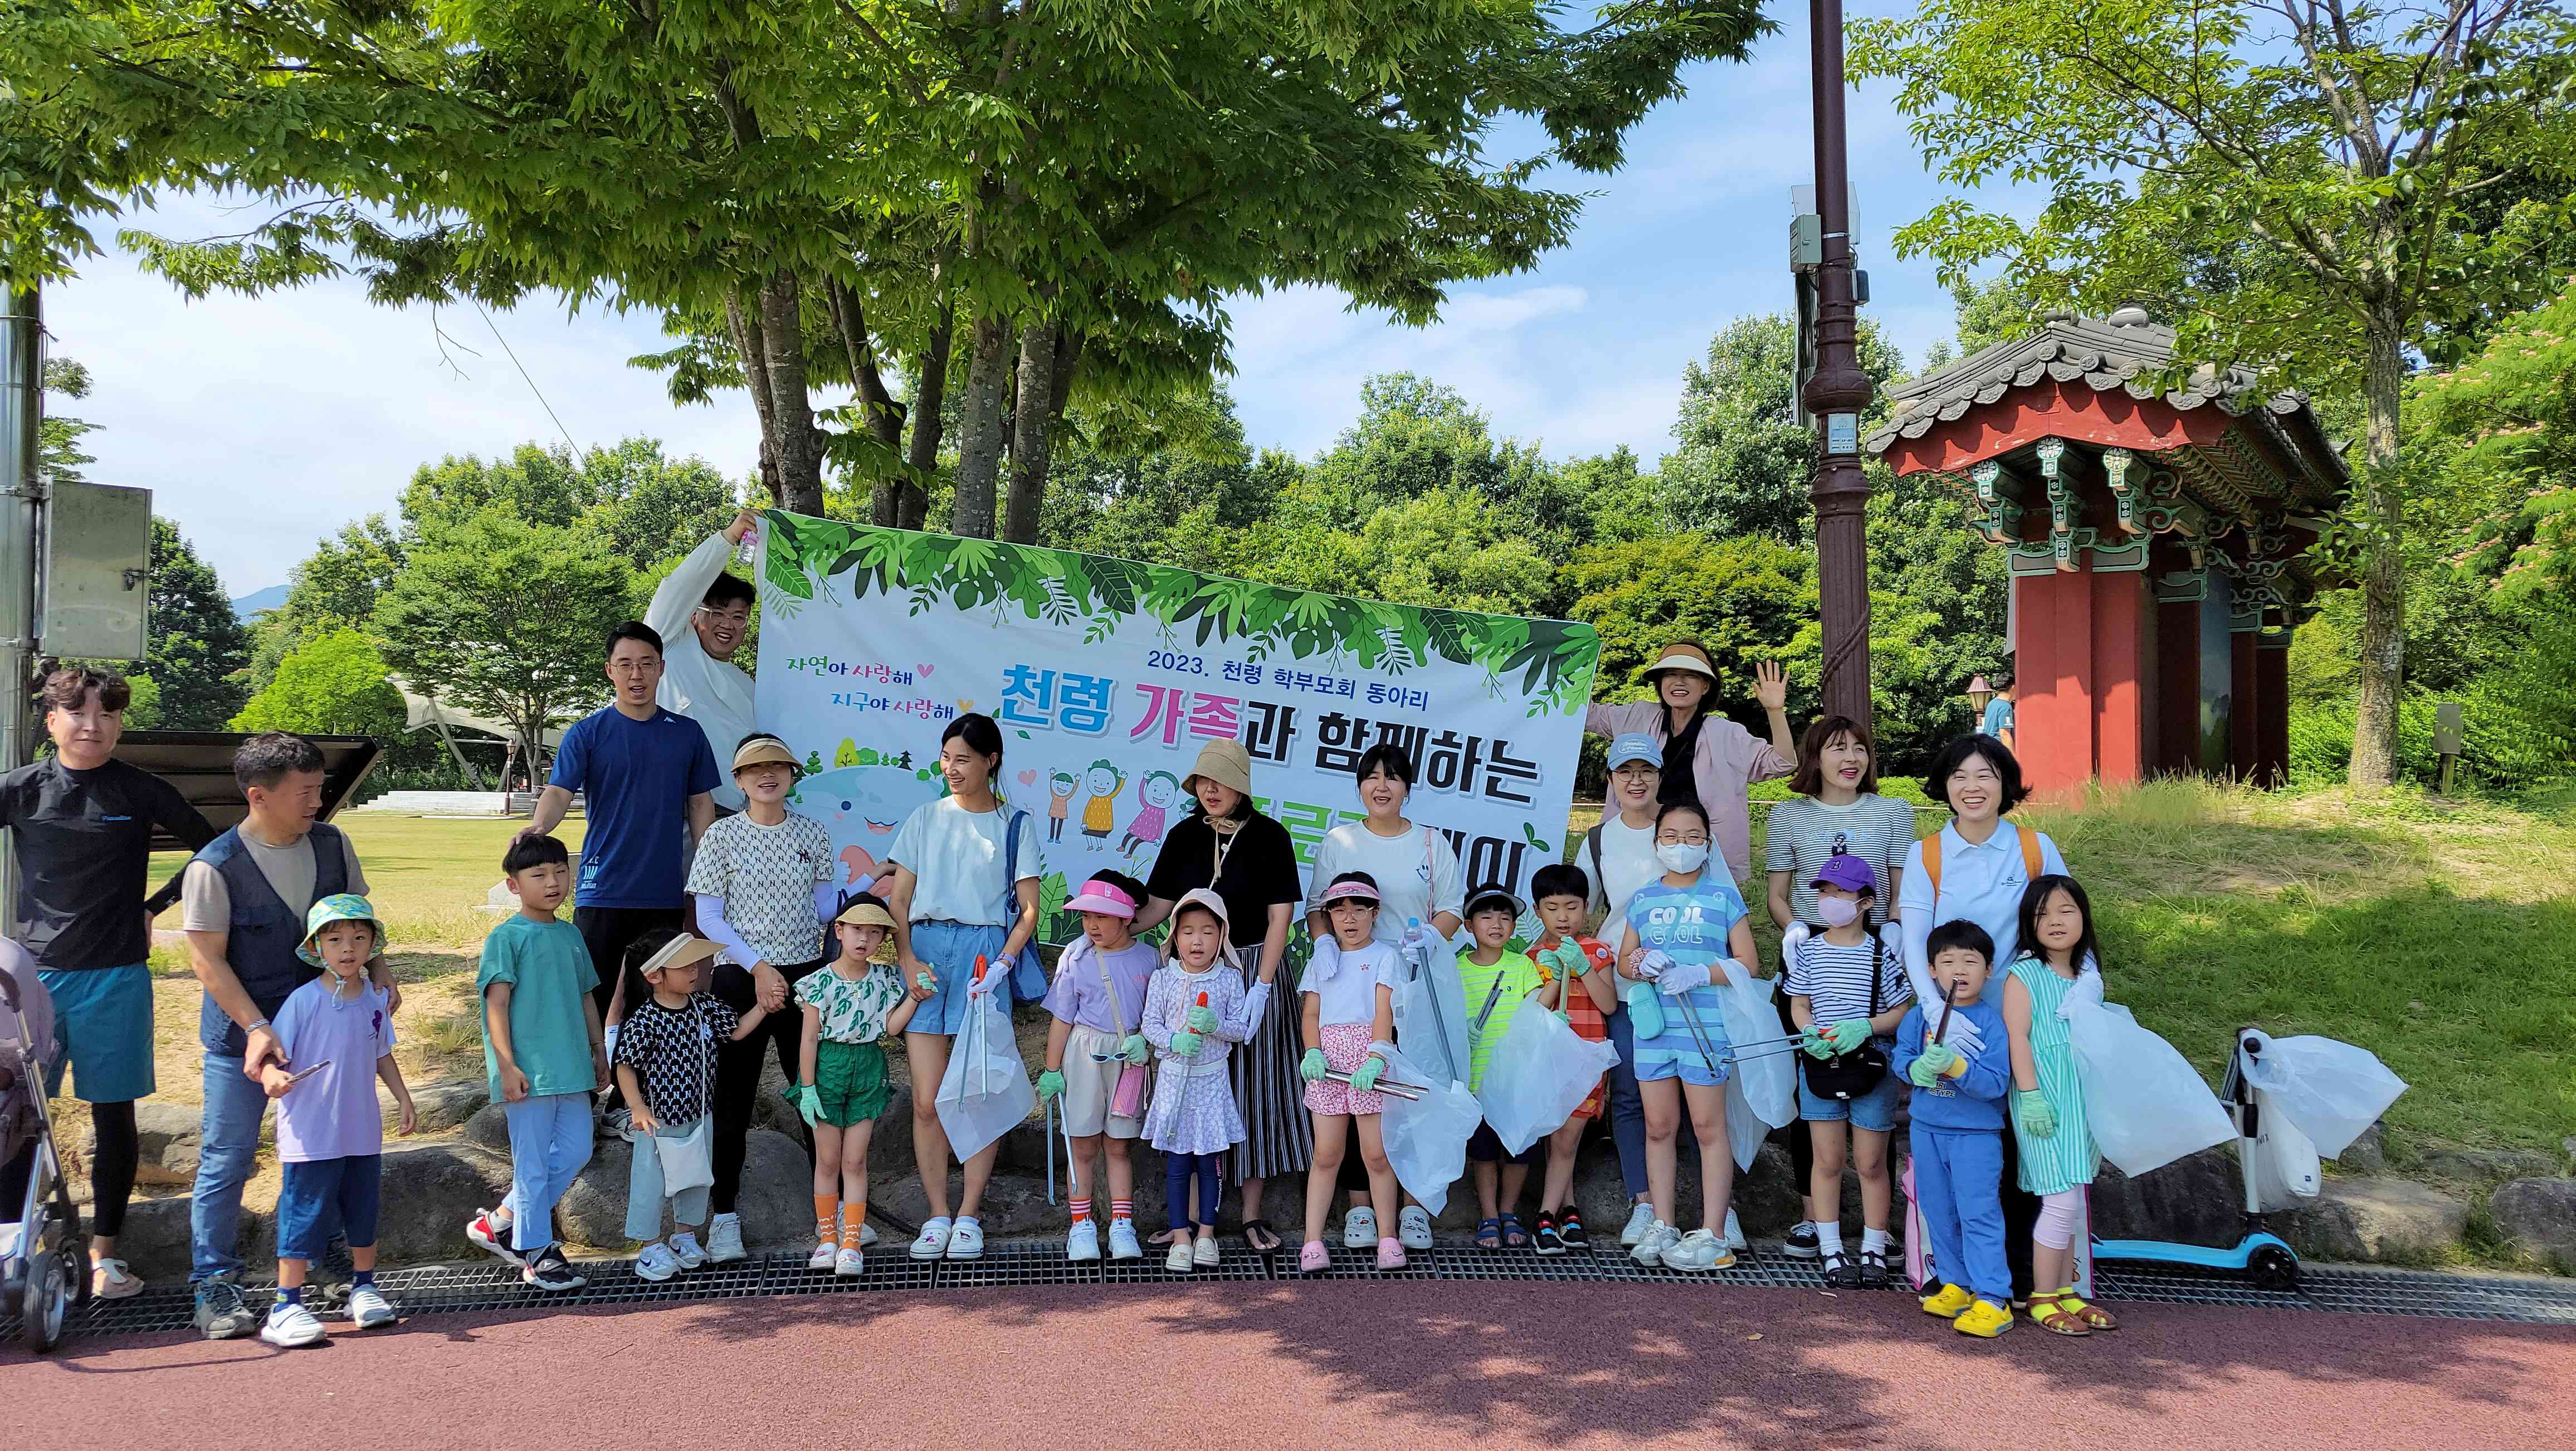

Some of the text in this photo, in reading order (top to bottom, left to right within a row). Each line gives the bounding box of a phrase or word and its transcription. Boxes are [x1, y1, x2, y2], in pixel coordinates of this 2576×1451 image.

[787, 656, 912, 685] 자연아 사랑해
[1148, 651, 1429, 712] 2023. 천령 학부모회 동아리
[830, 692, 953, 720] 지구야 사랑해
[1002, 664, 1538, 804] 천령 가족과 함께하는
[1829, 860, 1843, 871] B
[1648, 907, 1704, 925] COOL
